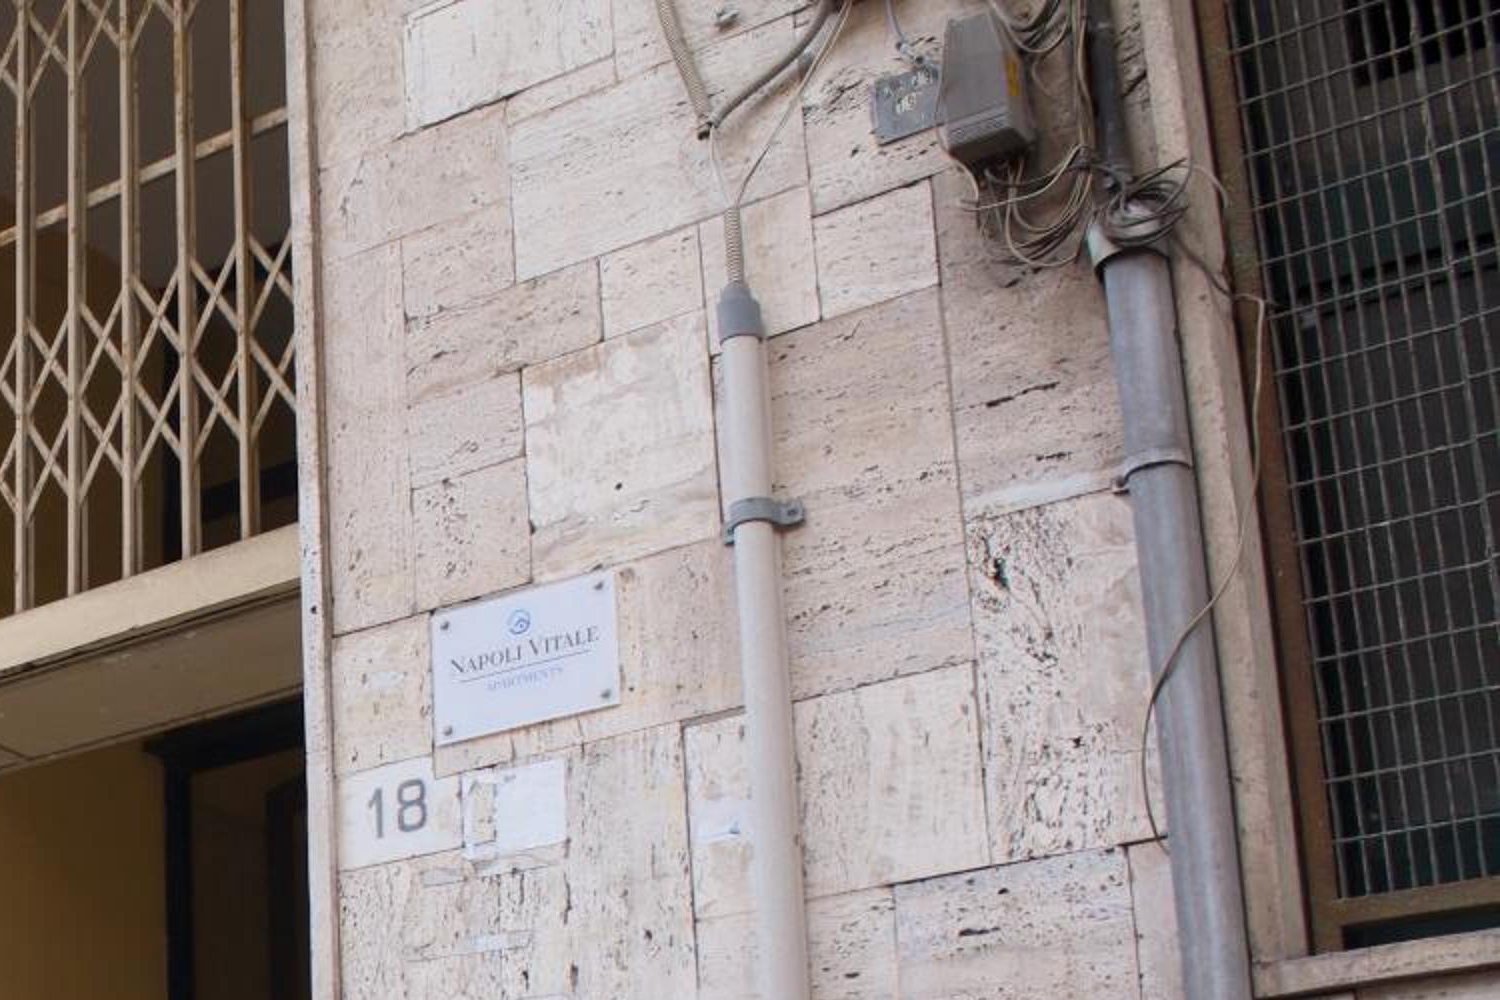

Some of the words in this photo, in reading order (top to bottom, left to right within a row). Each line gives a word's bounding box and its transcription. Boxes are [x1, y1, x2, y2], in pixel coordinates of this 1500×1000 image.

[451, 645, 522, 674] NAPOLI
[528, 627, 599, 655] VITALE
[367, 777, 429, 839] 18
